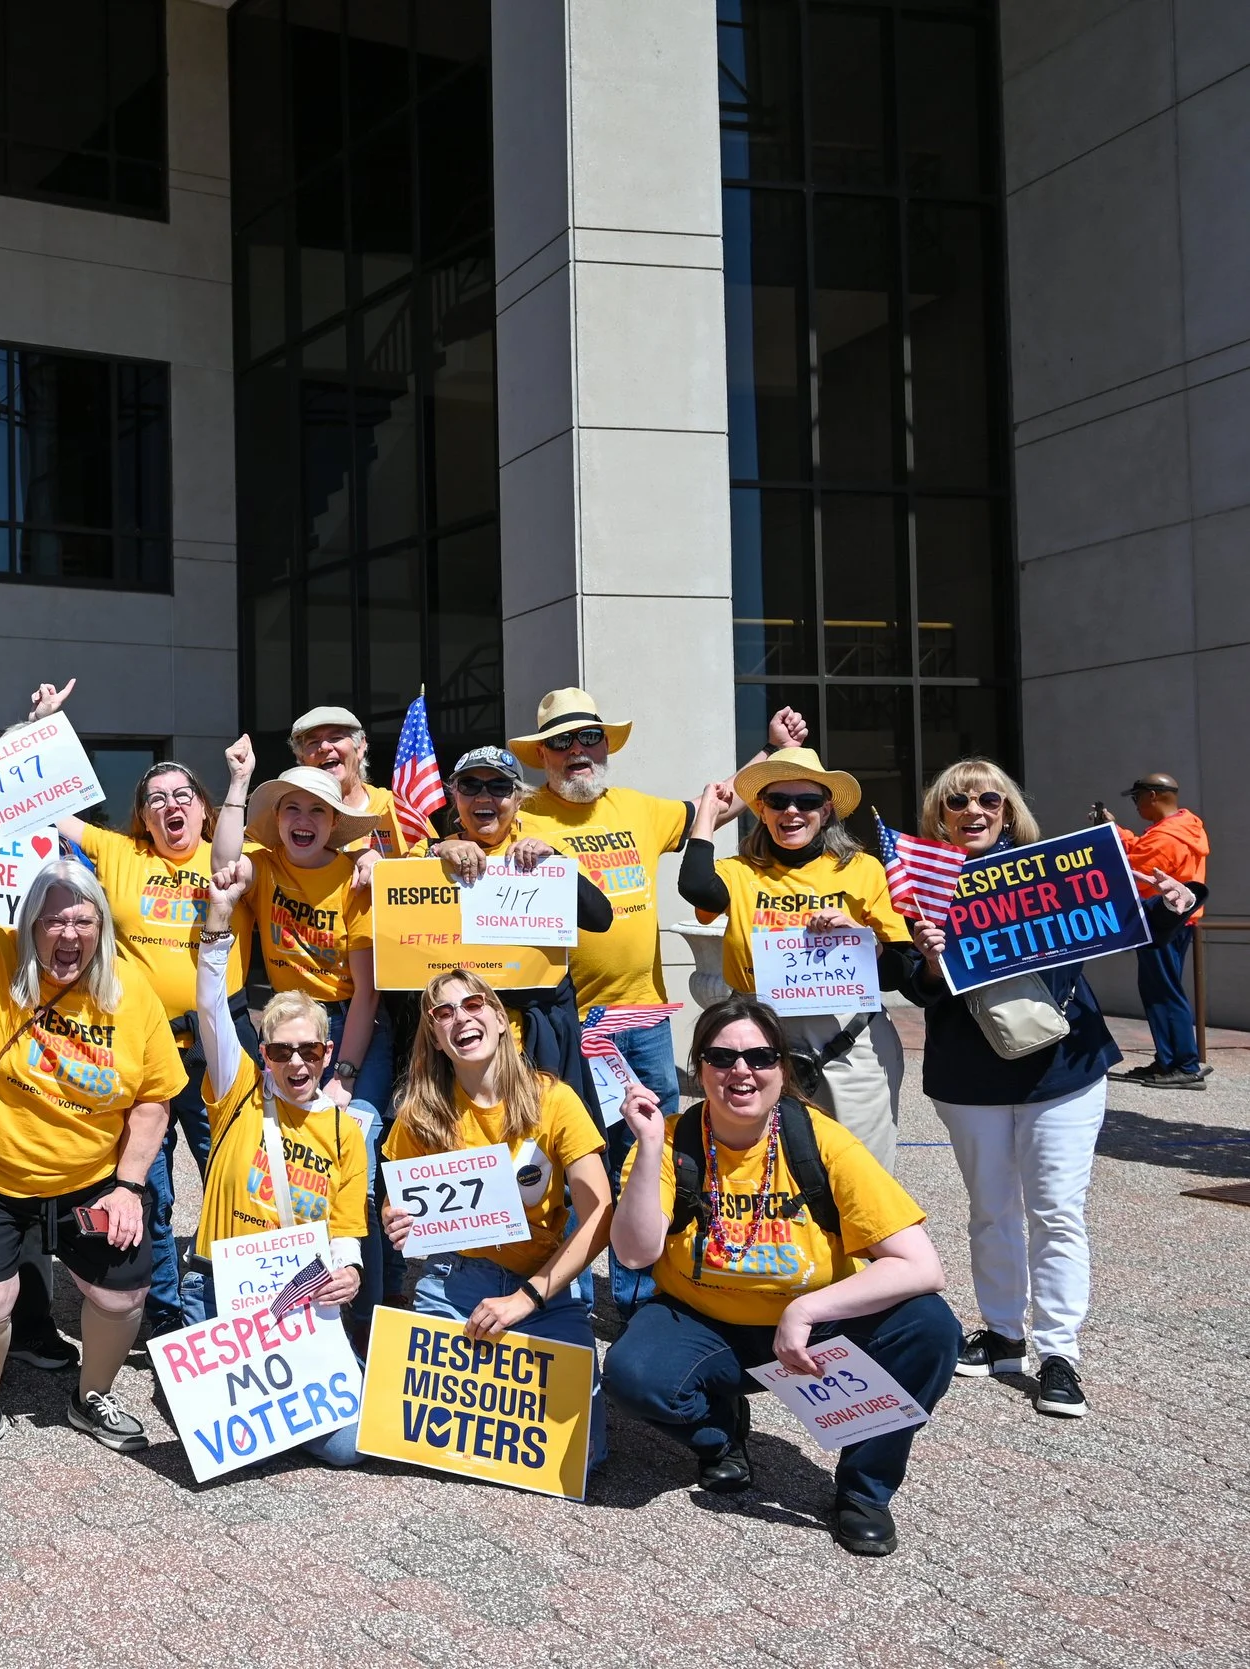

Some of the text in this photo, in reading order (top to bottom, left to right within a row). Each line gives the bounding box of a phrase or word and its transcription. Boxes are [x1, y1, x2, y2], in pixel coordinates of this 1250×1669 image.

[563, 831, 636, 852] RESPECT
[147, 870, 210, 890] RESPEC
[954, 847, 1094, 900] ESPECT our
[387, 886, 460, 905] RESPECT
[496, 886, 540, 914] 417
[756, 891, 845, 912] RESPECT
[950, 869, 1109, 935] POWER TO
[140, 896, 207, 922] VOTER
[476, 915, 563, 929] SIGNATURES
[752, 910, 811, 927] MISSO
[129, 934, 200, 950] respectMOvote
[400, 934, 422, 945] LET
[425, 933, 449, 945] THE
[765, 935, 861, 950] I COLLECTED
[958, 902, 1121, 970] PETITION
[783, 948, 850, 968] 379 +
[786, 966, 856, 986] NOTARY
[771, 984, 865, 999] SIGNATURES
[27, 1038, 115, 1095] VOTERS
[397, 1155, 497, 1182] I COLLECTED
[402, 1178, 484, 1218] 527
[413, 1211, 510, 1237] SIGNATURES
[224, 1232, 315, 1258] I COLLECTED
[255, 1254, 300, 1269] 274
[407, 1326, 554, 1389] RESPECT
[226, 1353, 293, 1406] MO
[764, 1372, 776, 1382] I
[796, 1370, 868, 1406] 1093
[403, 1367, 547, 1423] MISSOURI
[193, 1372, 359, 1465] VOTERS
[814, 1394, 900, 1429] SIGNATURES
[403, 1400, 548, 1469] VOTERS
